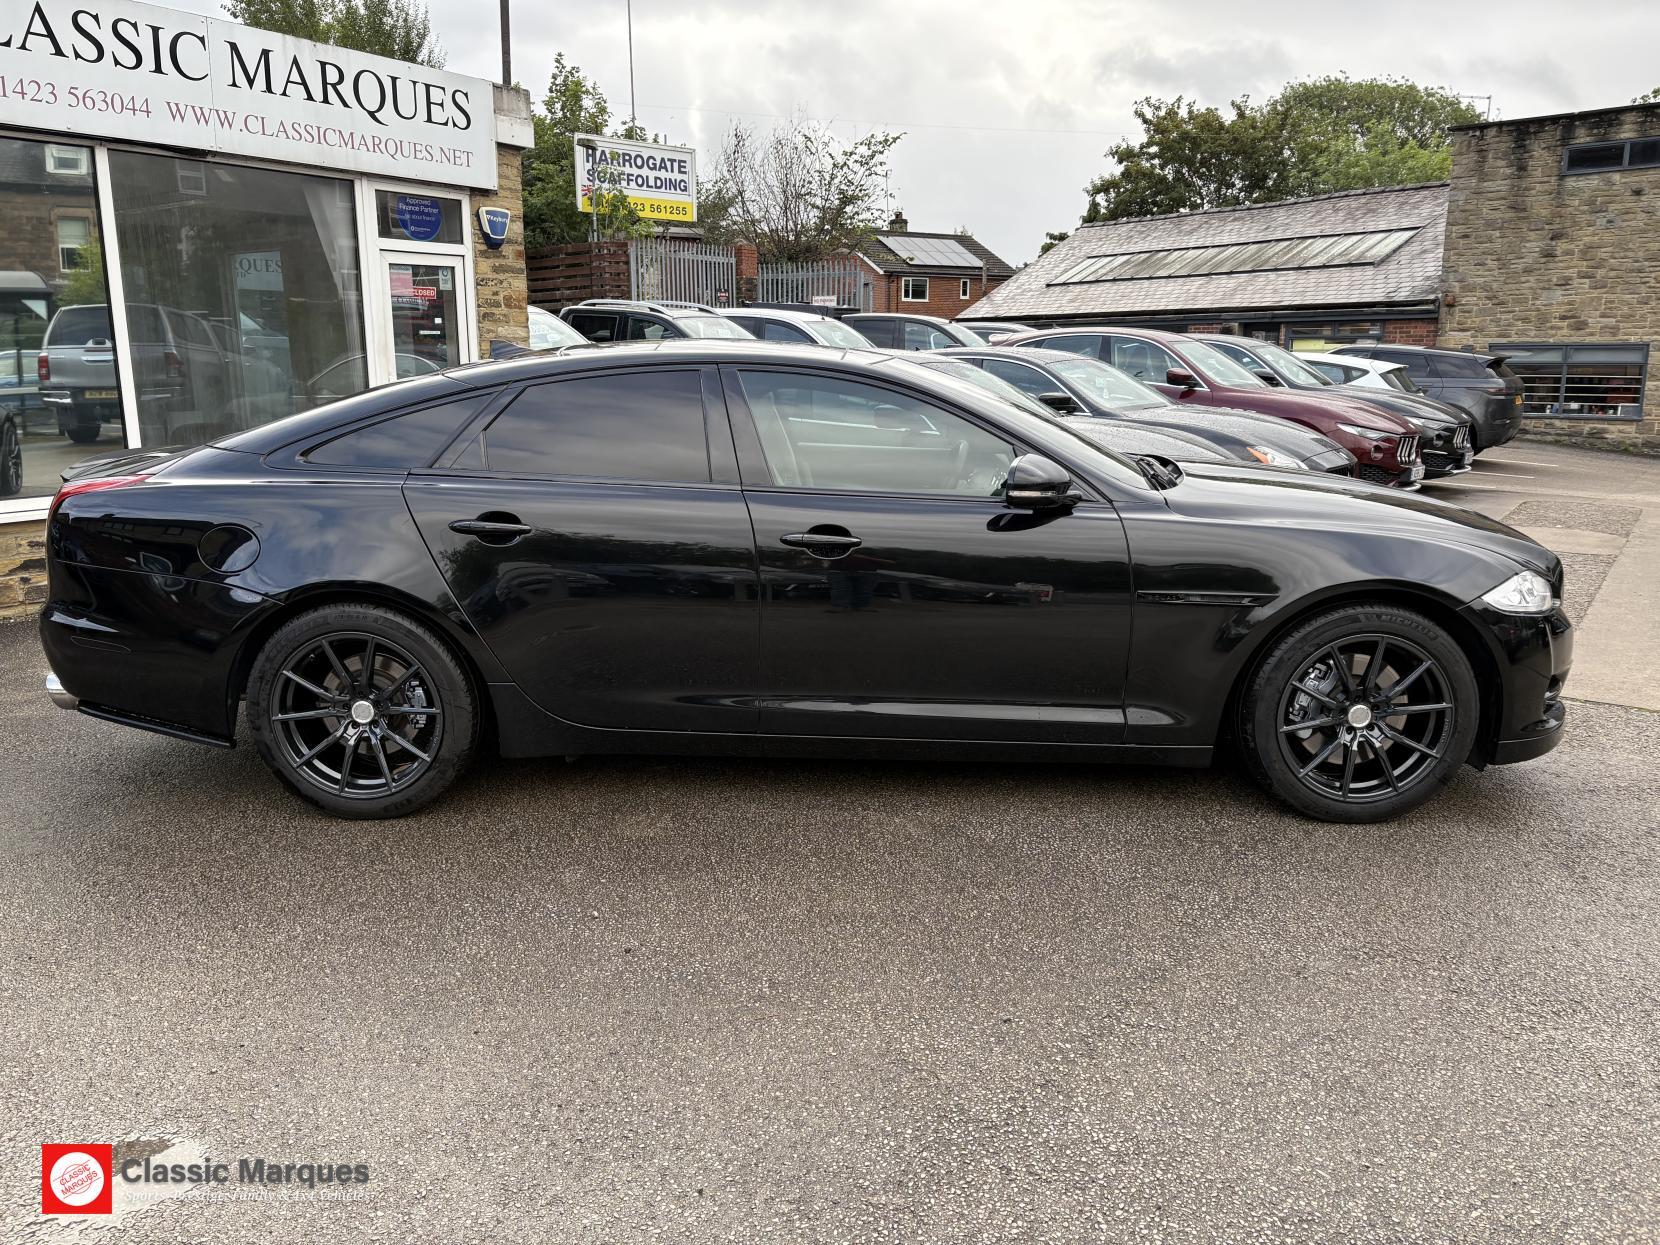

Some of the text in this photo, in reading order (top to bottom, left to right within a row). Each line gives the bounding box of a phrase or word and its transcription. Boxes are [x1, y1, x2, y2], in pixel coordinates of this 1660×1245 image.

[0, 75, 57, 104] 1423
[67, 84, 152, 118] 563044
[224, 40, 472, 130] MARQUES
[649, 203, 687, 216] 561255
